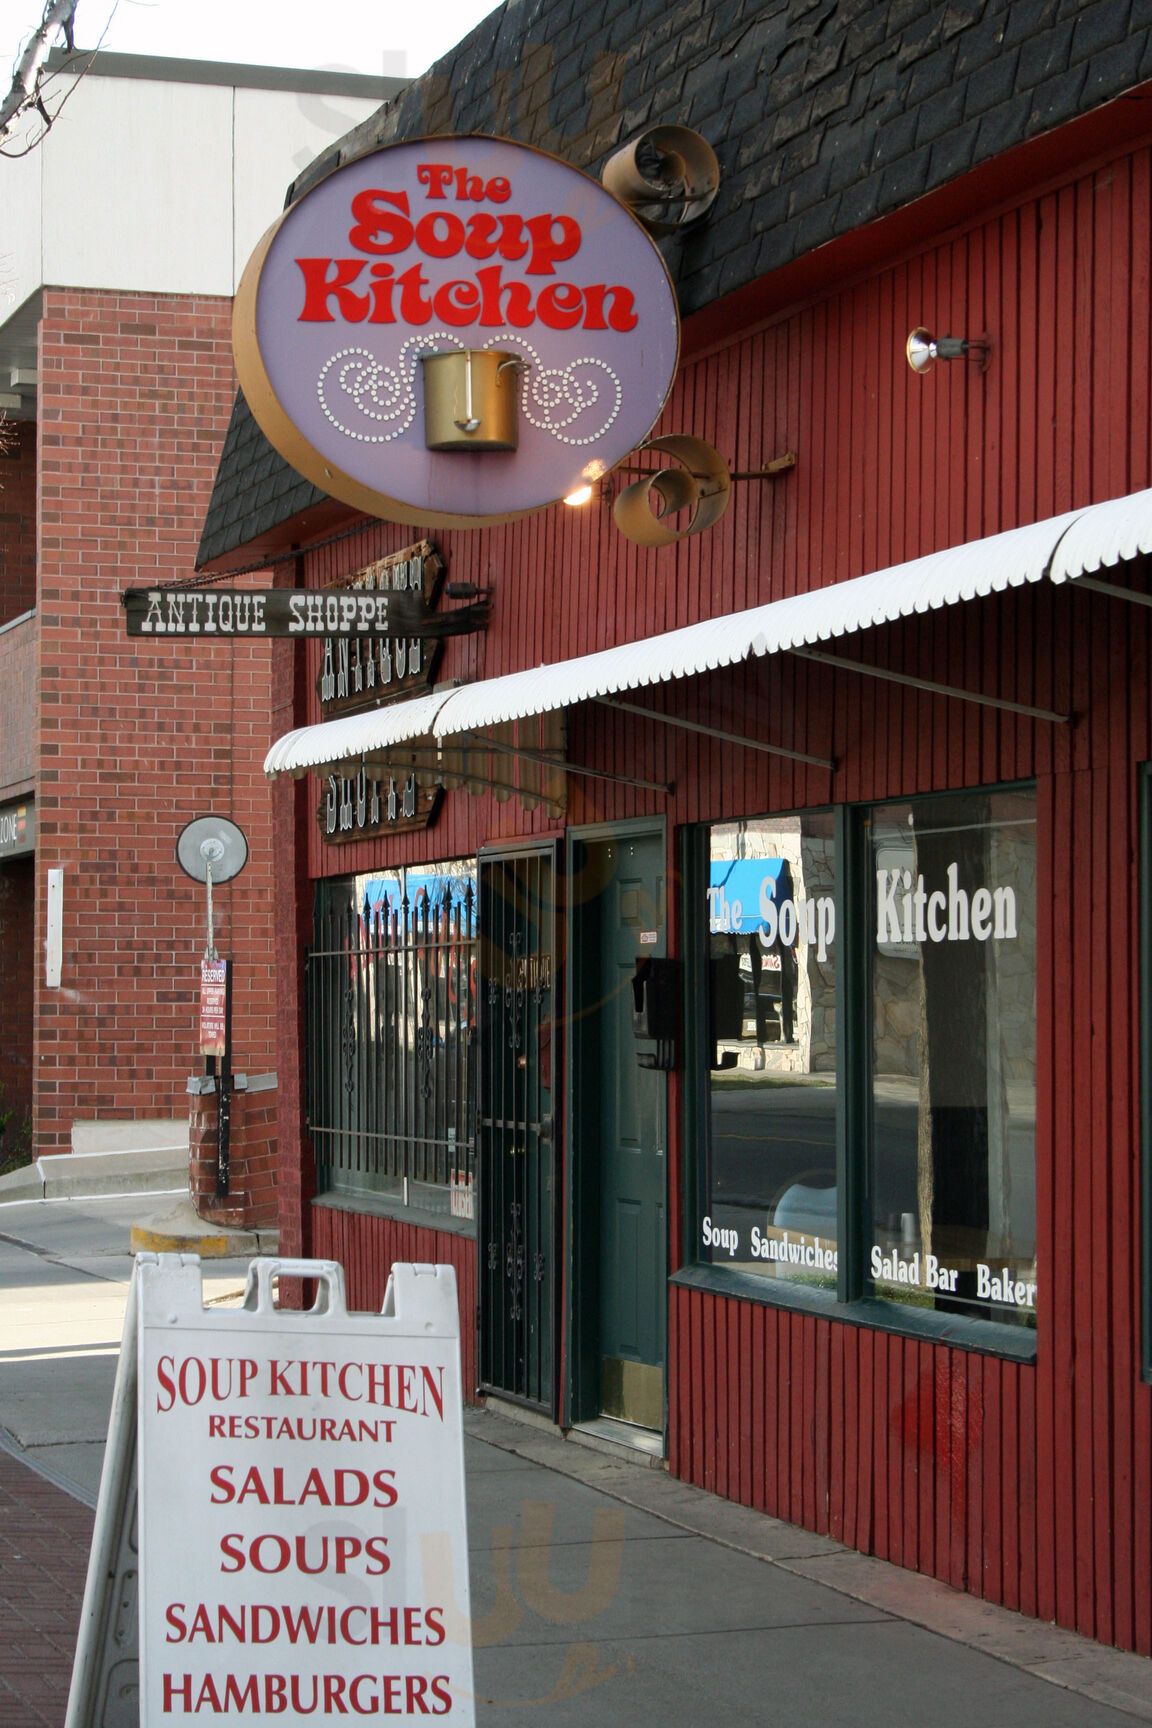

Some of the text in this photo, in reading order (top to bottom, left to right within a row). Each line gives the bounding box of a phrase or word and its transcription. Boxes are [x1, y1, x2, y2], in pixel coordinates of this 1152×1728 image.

[417, 164, 512, 204] The
[349, 188, 582, 275] Soup
[294, 257, 639, 332] Kitchen
[141, 592, 389, 633] ANTIQUE SHOPPE
[707, 862, 1018, 963] The Soup Kitchen
[201, 969, 225, 983] RESERVED
[702, 1216, 739, 1257] Soup
[871, 1245, 921, 1286] Salad
[925, 1254, 959, 1292] Bar
[156, 1355, 446, 1423] SOUP KITCHEN
[208, 1415, 398, 1443] RESTAURANT
[209, 1464, 399, 1509] SALADS
[220, 1533, 391, 1576] SOUPS
[165, 1602, 446, 1647] SANDWICHES
[162, 1673, 453, 1715] HAMBURGERS
